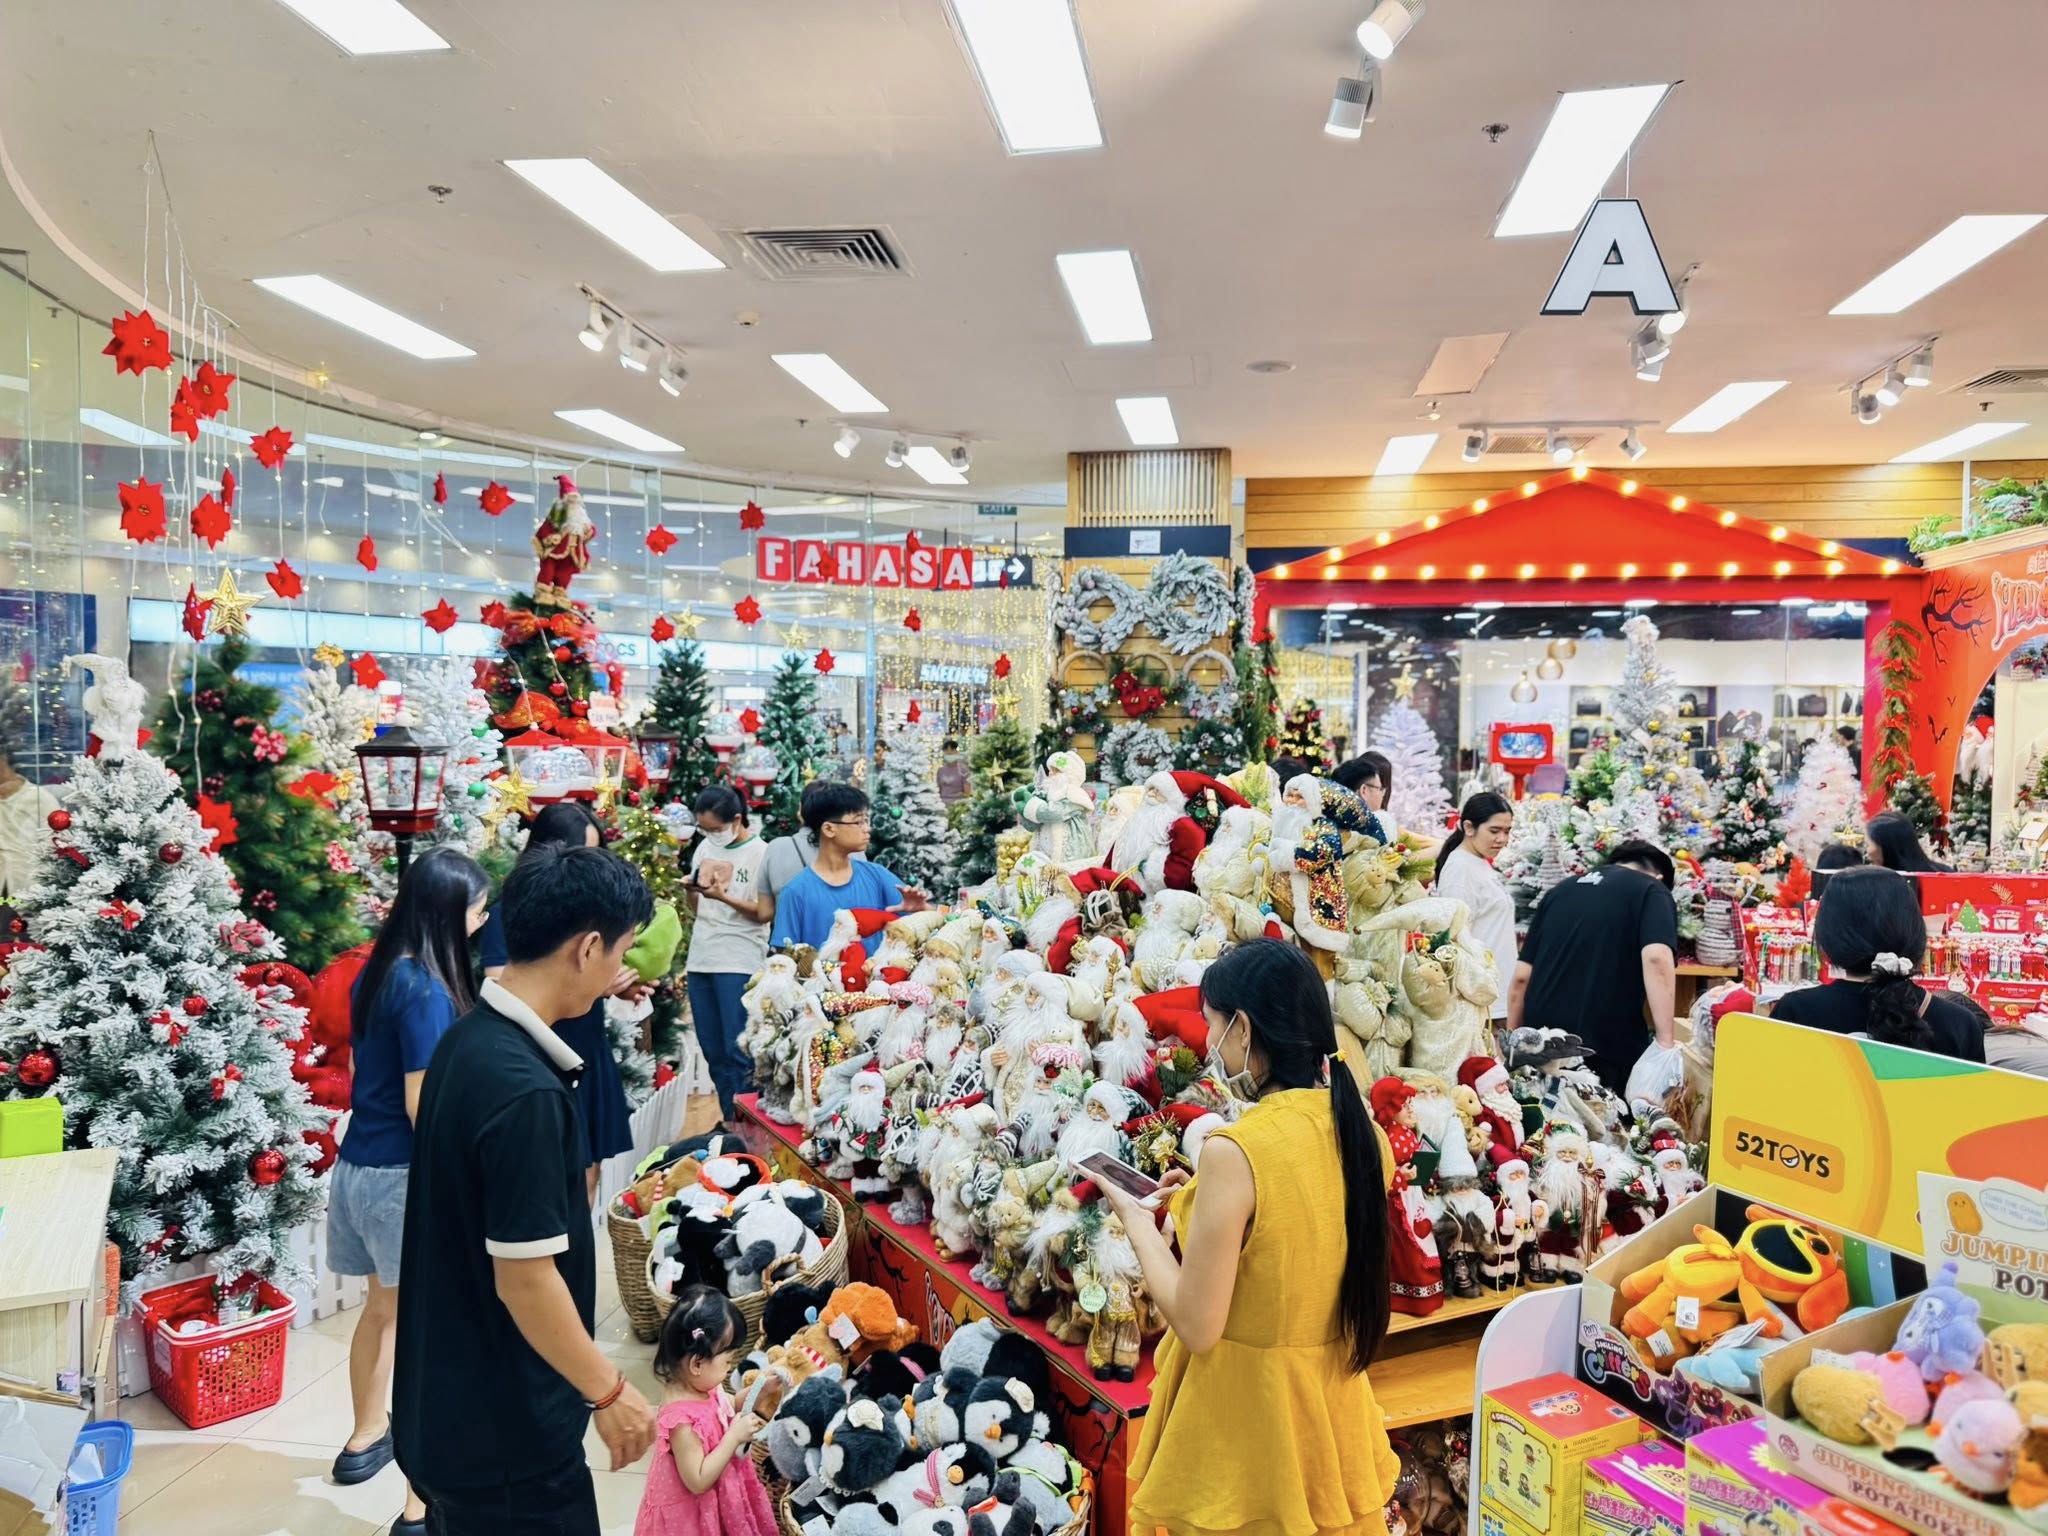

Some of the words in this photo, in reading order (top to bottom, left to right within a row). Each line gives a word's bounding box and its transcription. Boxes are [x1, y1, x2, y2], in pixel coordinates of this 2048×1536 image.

[1540, 199, 1681, 315] A
[764, 540, 970, 586] FAHASA
[1735, 1131, 1830, 1178] 52TOYS
[1813, 1445, 1913, 1501] JUMPING
